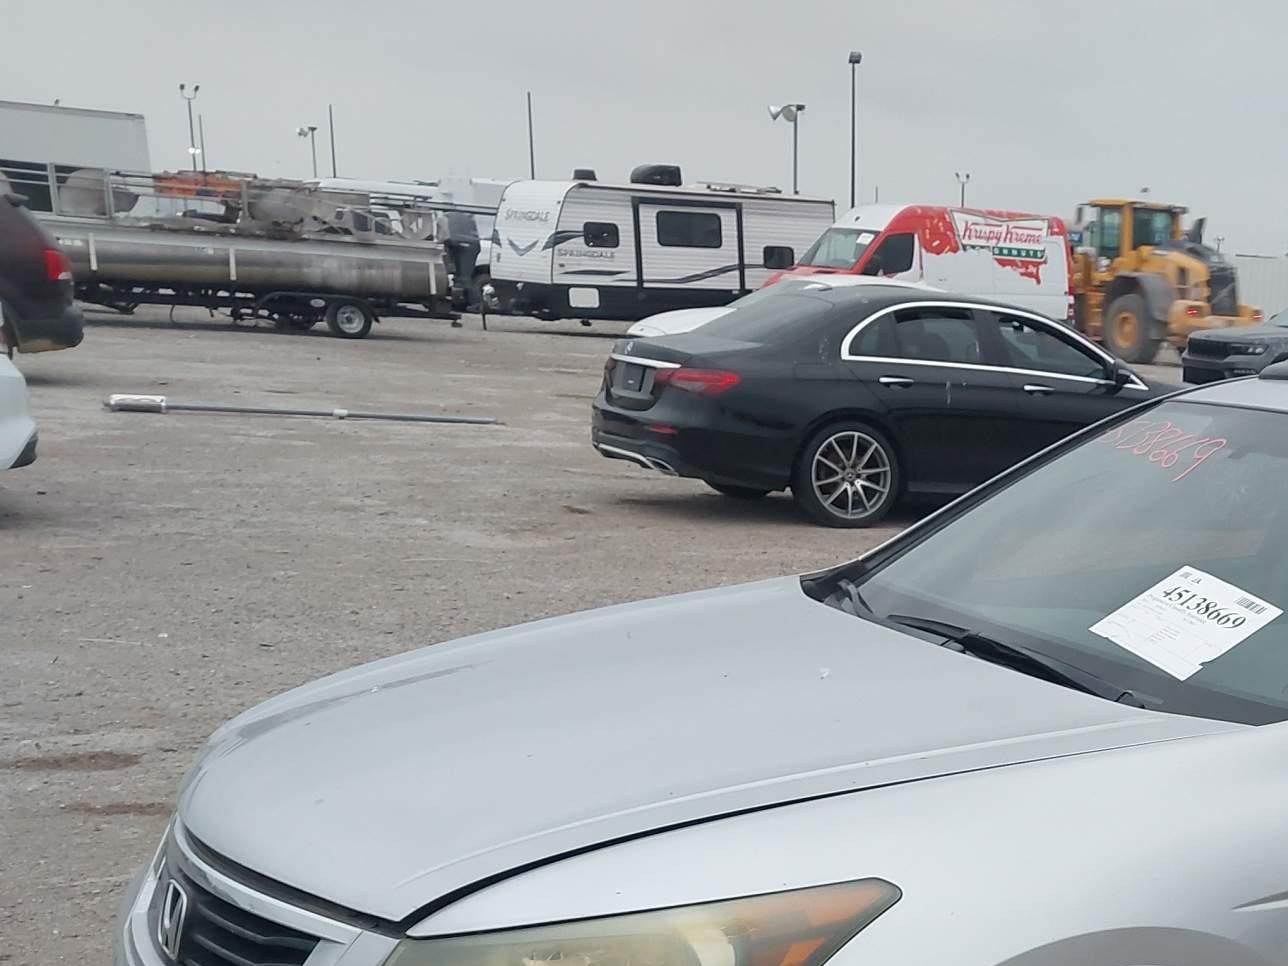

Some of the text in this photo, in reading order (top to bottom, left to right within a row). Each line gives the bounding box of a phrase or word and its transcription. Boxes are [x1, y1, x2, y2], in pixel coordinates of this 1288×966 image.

[962, 221, 1003, 246] Krispy
[1003, 224, 1043, 244] Kreme
[1162, 586, 1247, 629] 45138669
